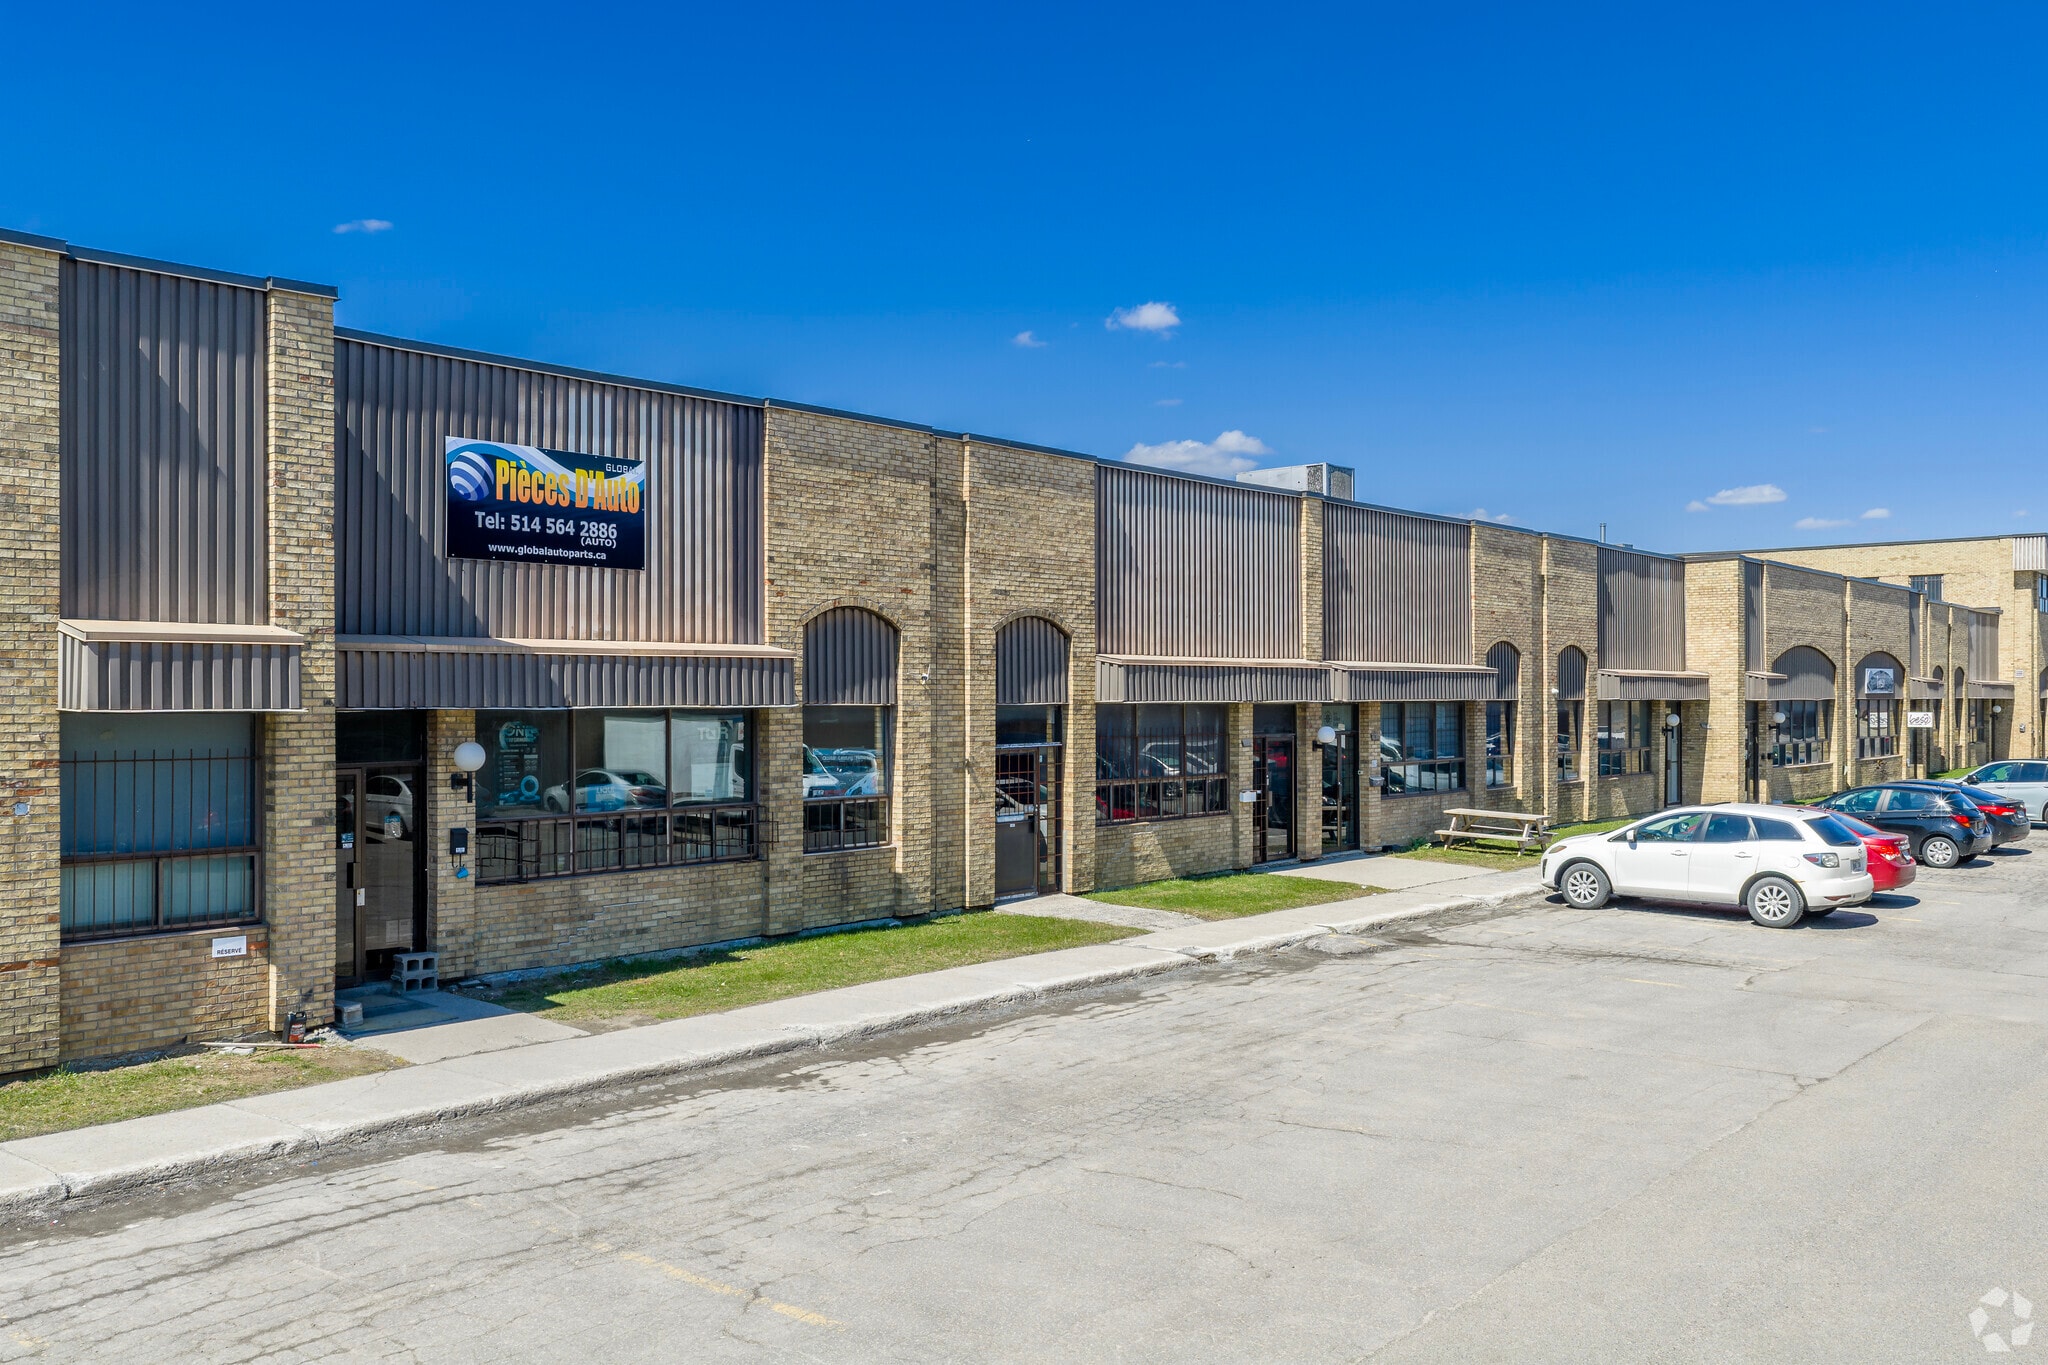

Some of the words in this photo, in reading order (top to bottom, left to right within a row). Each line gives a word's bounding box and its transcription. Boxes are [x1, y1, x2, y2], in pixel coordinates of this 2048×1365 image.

[495, 458, 570, 508] Pièces
[575, 468, 640, 514] D'Auto
[475, 511, 505, 530] Tel:
[511, 514, 541, 533] 514
[546, 517, 575, 536] 564
[580, 521, 618, 539] 2886
[581, 537, 617, 549] (AUTO)
[488, 544, 607, 560] www.globalautoparts.ca
[216, 946, 242, 956] RÉSERVÉ
